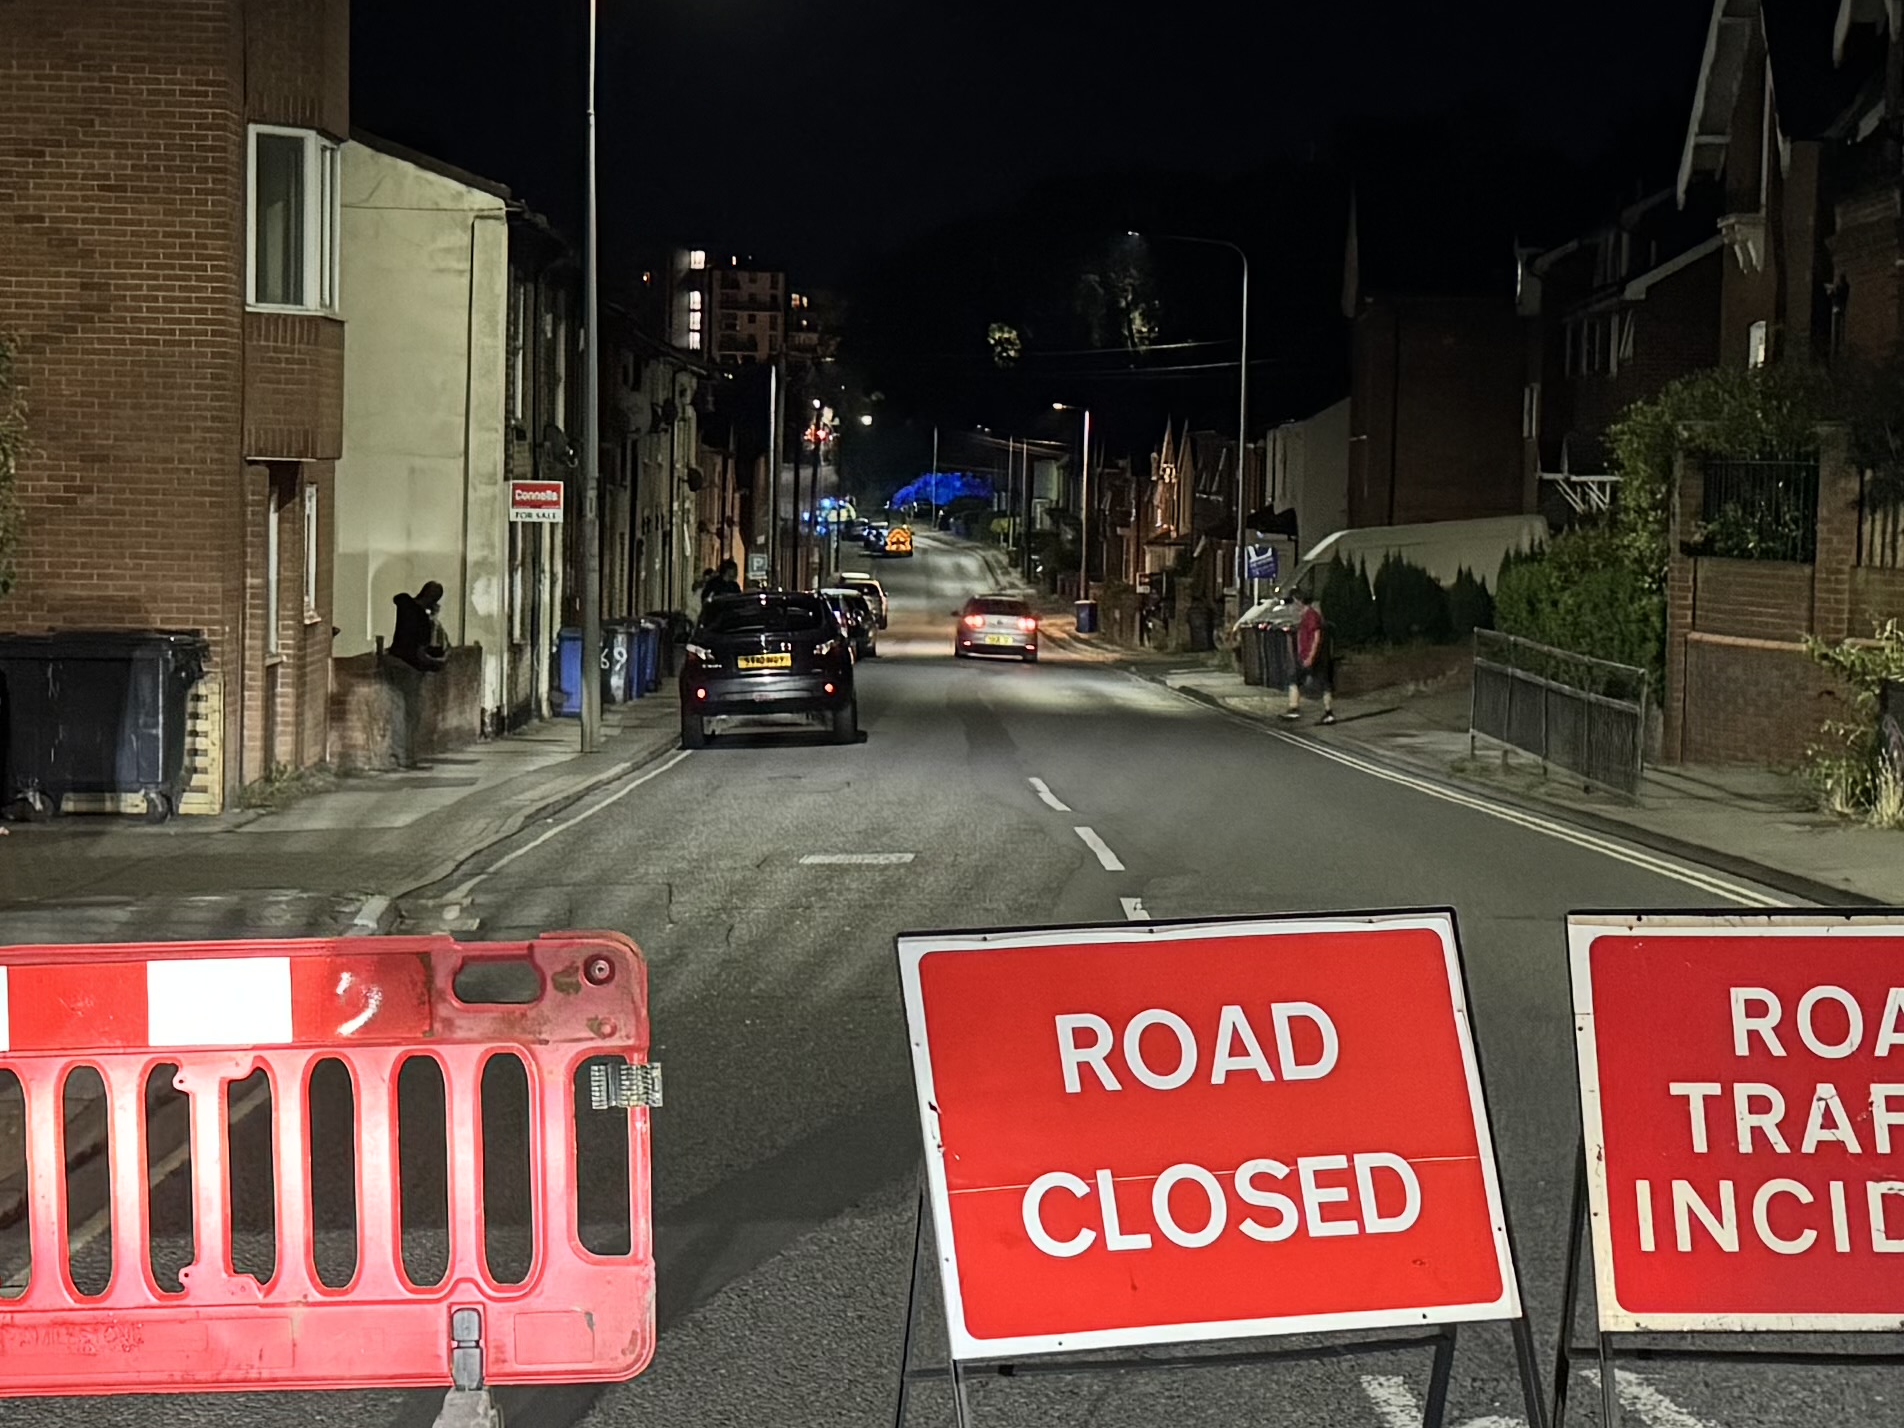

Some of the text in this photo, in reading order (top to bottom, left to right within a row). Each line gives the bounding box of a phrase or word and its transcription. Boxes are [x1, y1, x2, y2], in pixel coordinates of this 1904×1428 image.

[514, 489, 559, 501] Connells
[515, 511, 556, 519] FOR SALE
[753, 557, 764, 571] P
[1055, 1001, 1339, 1094] ROAD
[1021, 1152, 1422, 1258] CLOSED
